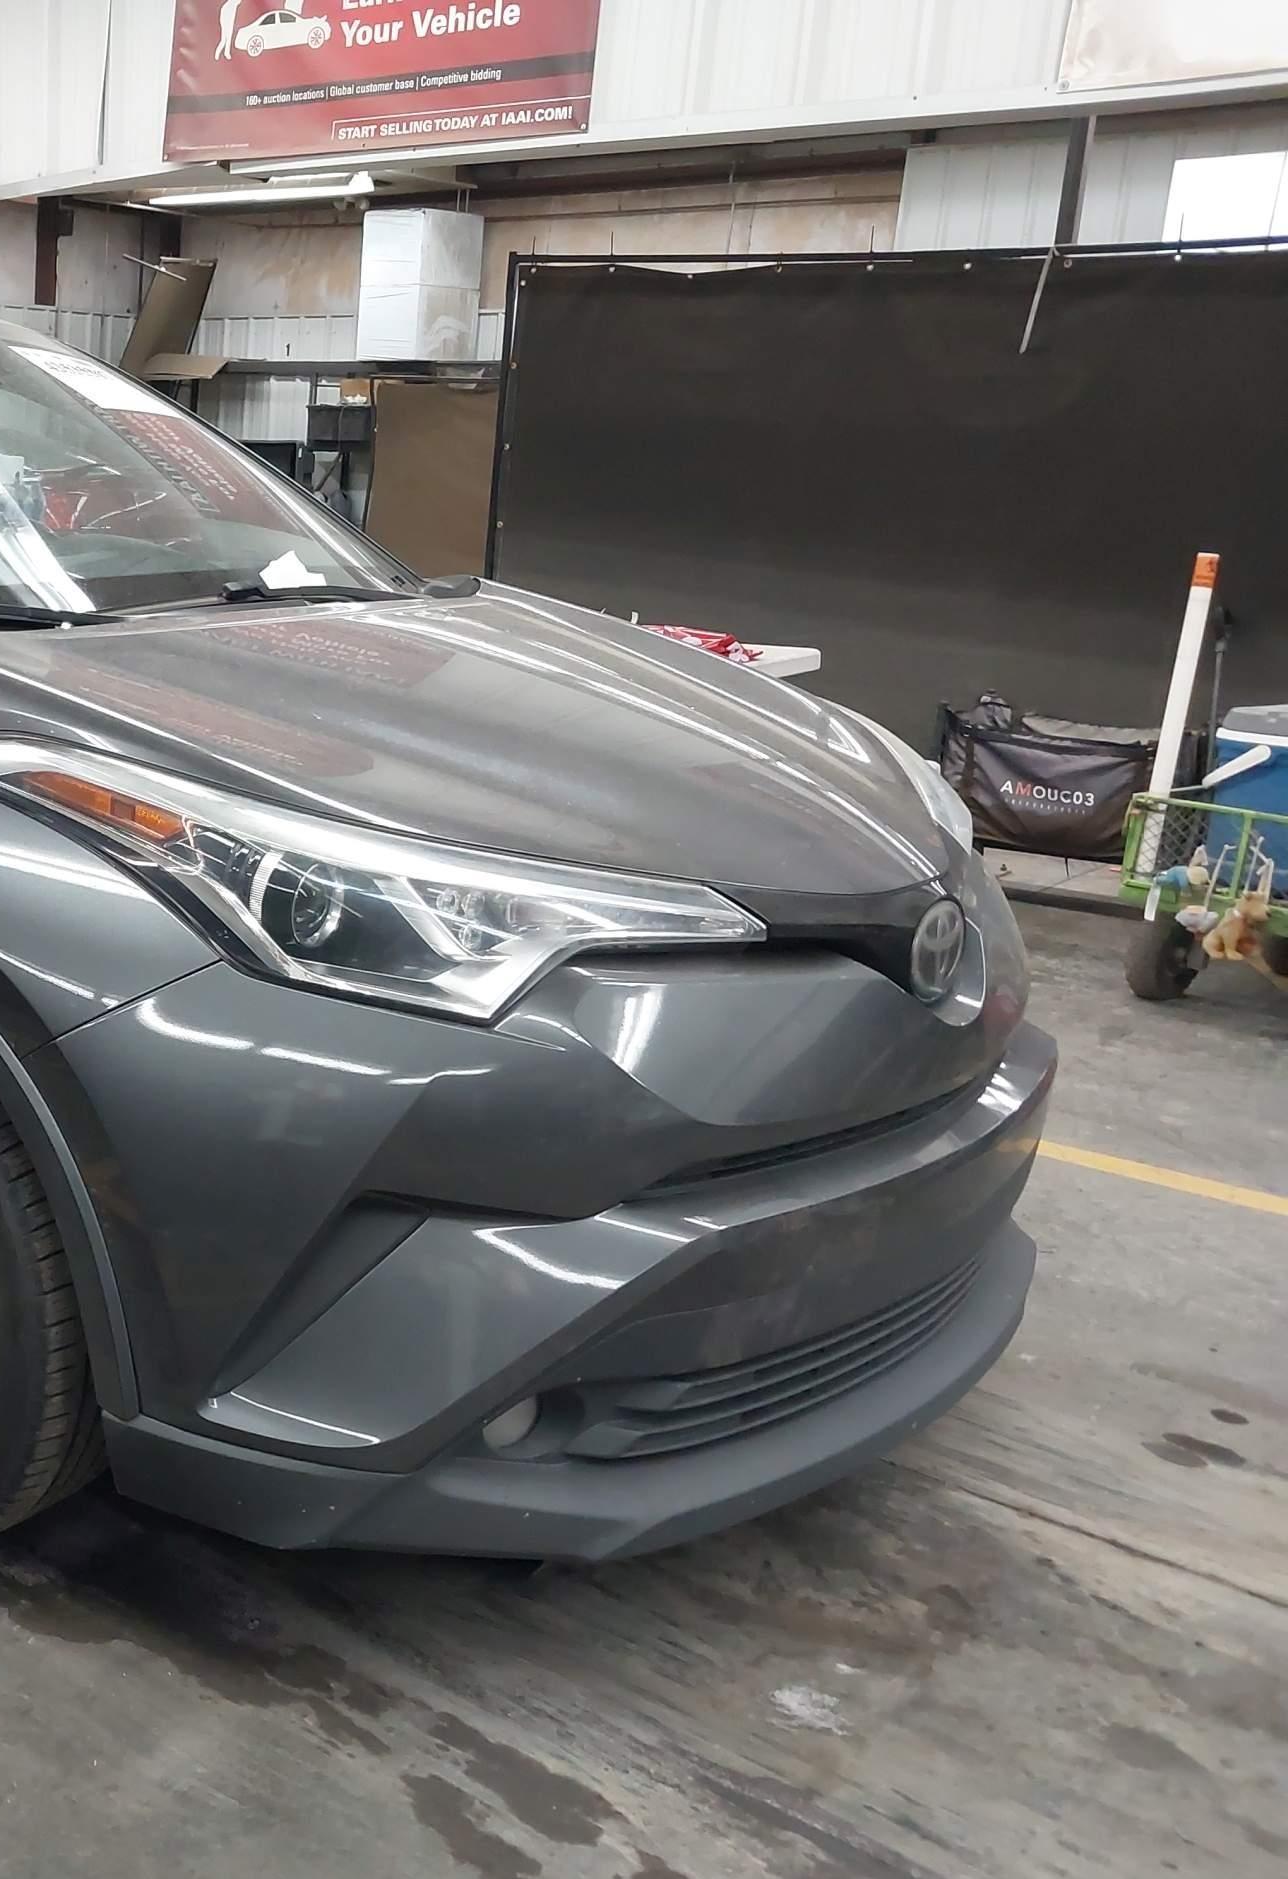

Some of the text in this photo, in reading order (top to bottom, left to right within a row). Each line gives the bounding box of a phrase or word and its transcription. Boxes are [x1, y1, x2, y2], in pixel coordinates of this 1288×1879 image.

[340, 0, 521, 47] Your Vehicle
[263, 92, 291, 105] auction
[292, 89, 324, 101] locations
[330, 84, 354, 96] Global
[355, 81, 394, 94] customer
[394, 80, 414, 90] base
[420, 71, 468, 87] Competitive
[470, 68, 502, 80] bidding
[338, 106, 573, 140] START SELLING TODAY AT IAAI.COM!
